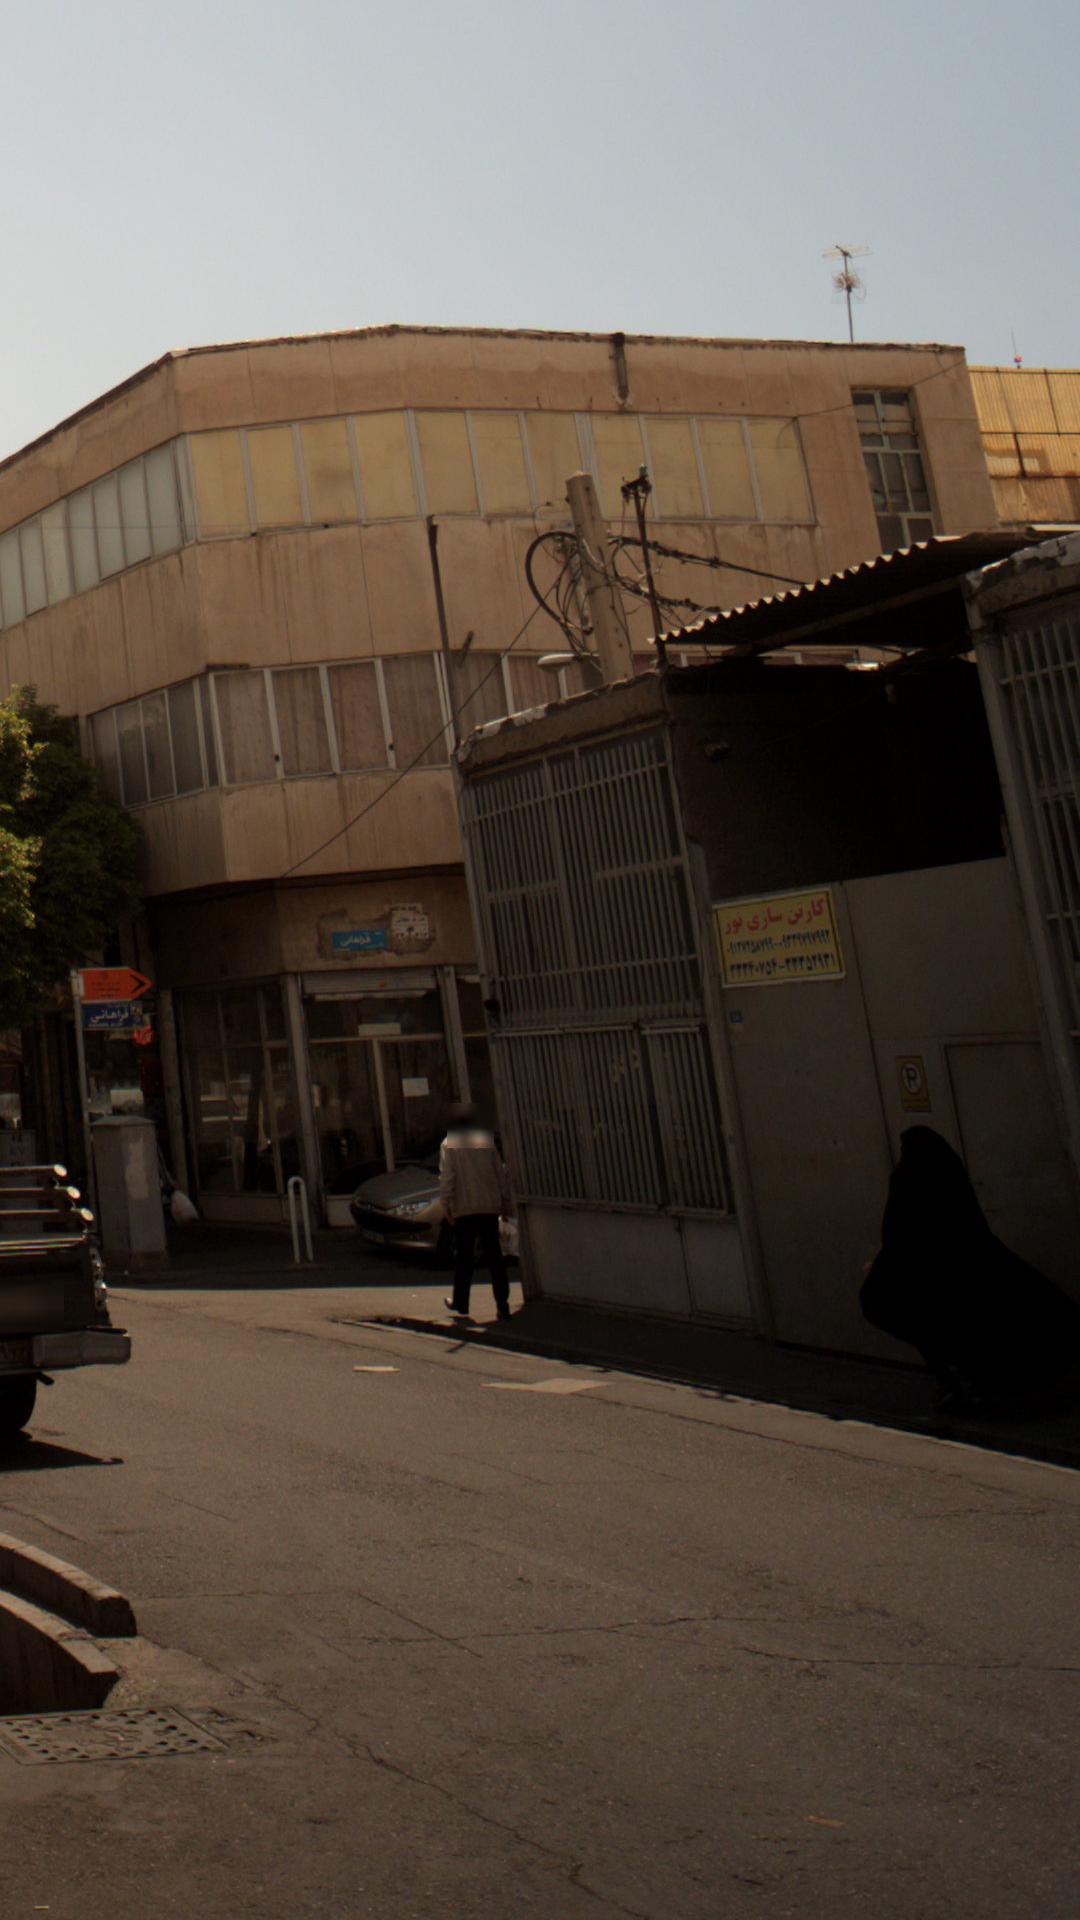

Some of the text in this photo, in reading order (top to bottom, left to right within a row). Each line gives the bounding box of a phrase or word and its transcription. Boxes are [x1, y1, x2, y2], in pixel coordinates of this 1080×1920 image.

[725, 898, 824, 934] کارتن سازی نور
